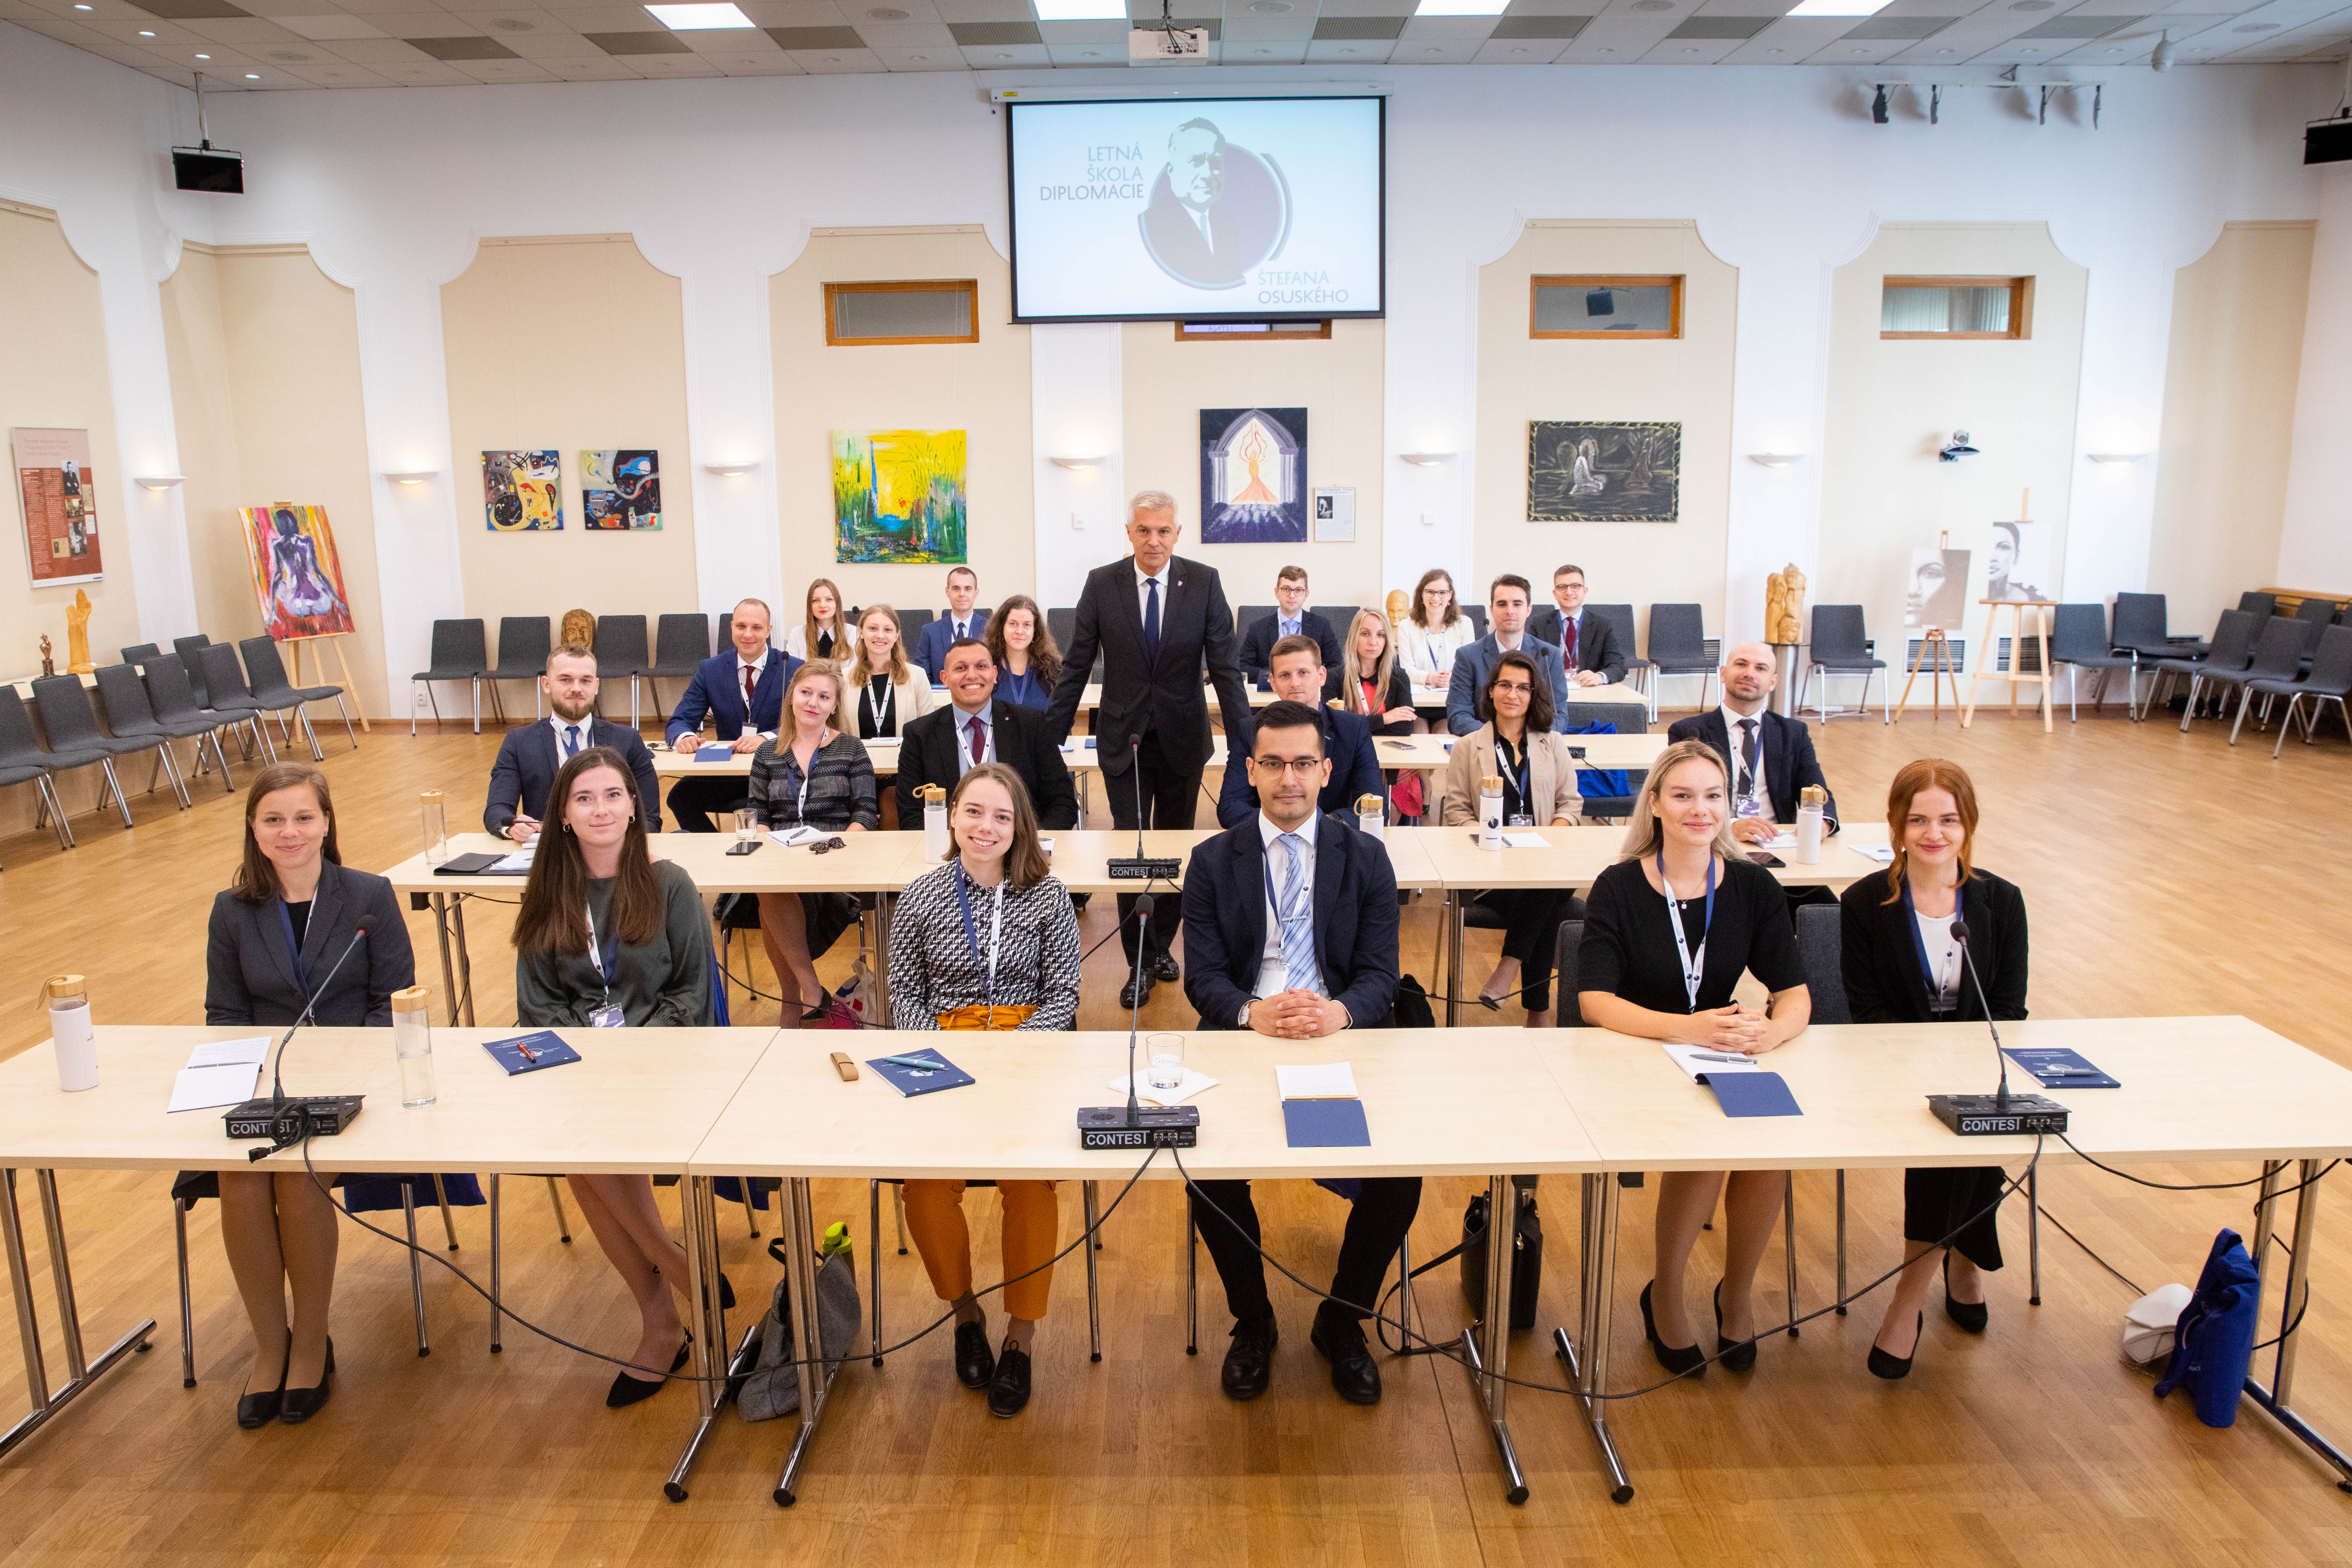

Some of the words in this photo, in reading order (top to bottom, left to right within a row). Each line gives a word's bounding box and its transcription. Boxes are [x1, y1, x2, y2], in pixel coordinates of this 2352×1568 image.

[1088, 141, 1143, 161] LETNÁ
[1087, 164, 1143, 182] ŠKOLA
[1040, 184, 1144, 201] DIPLOMACIE
[1258, 268, 1330, 286] ŠTEFANA
[1258, 286, 1349, 304] OSUSKÉHO
[1112, 867, 1150, 876] CONTEST
[230, 1119, 293, 1134] CONTST
[1962, 1117, 2023, 1131] CONTEST
[1086, 1130, 1150, 1145] CONTEST
